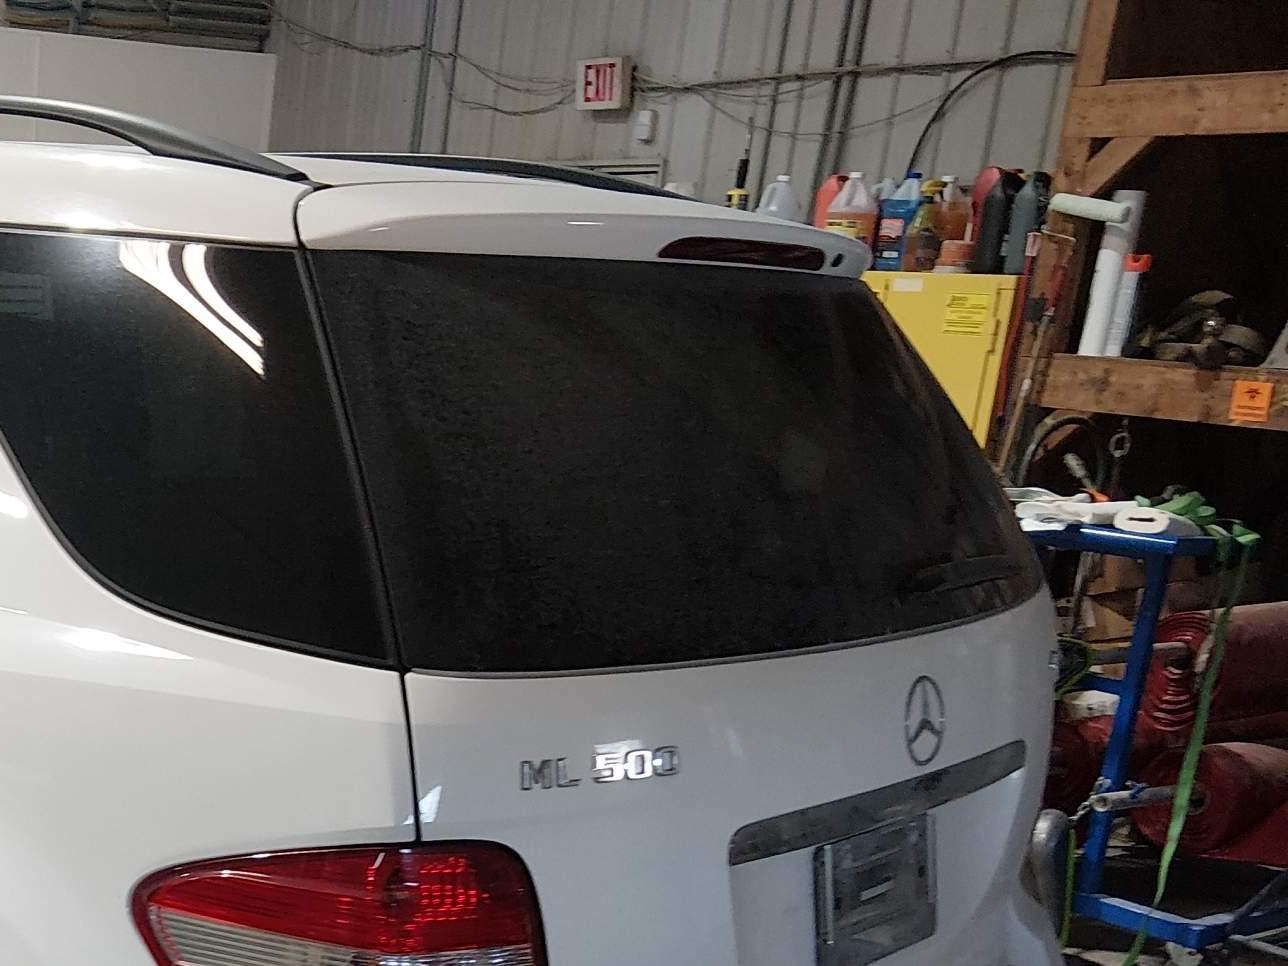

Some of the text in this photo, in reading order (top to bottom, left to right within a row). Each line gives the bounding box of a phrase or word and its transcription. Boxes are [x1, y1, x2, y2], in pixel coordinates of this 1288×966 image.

[583, 63, 617, 103] EXIT
[520, 745, 680, 790] ML 500
